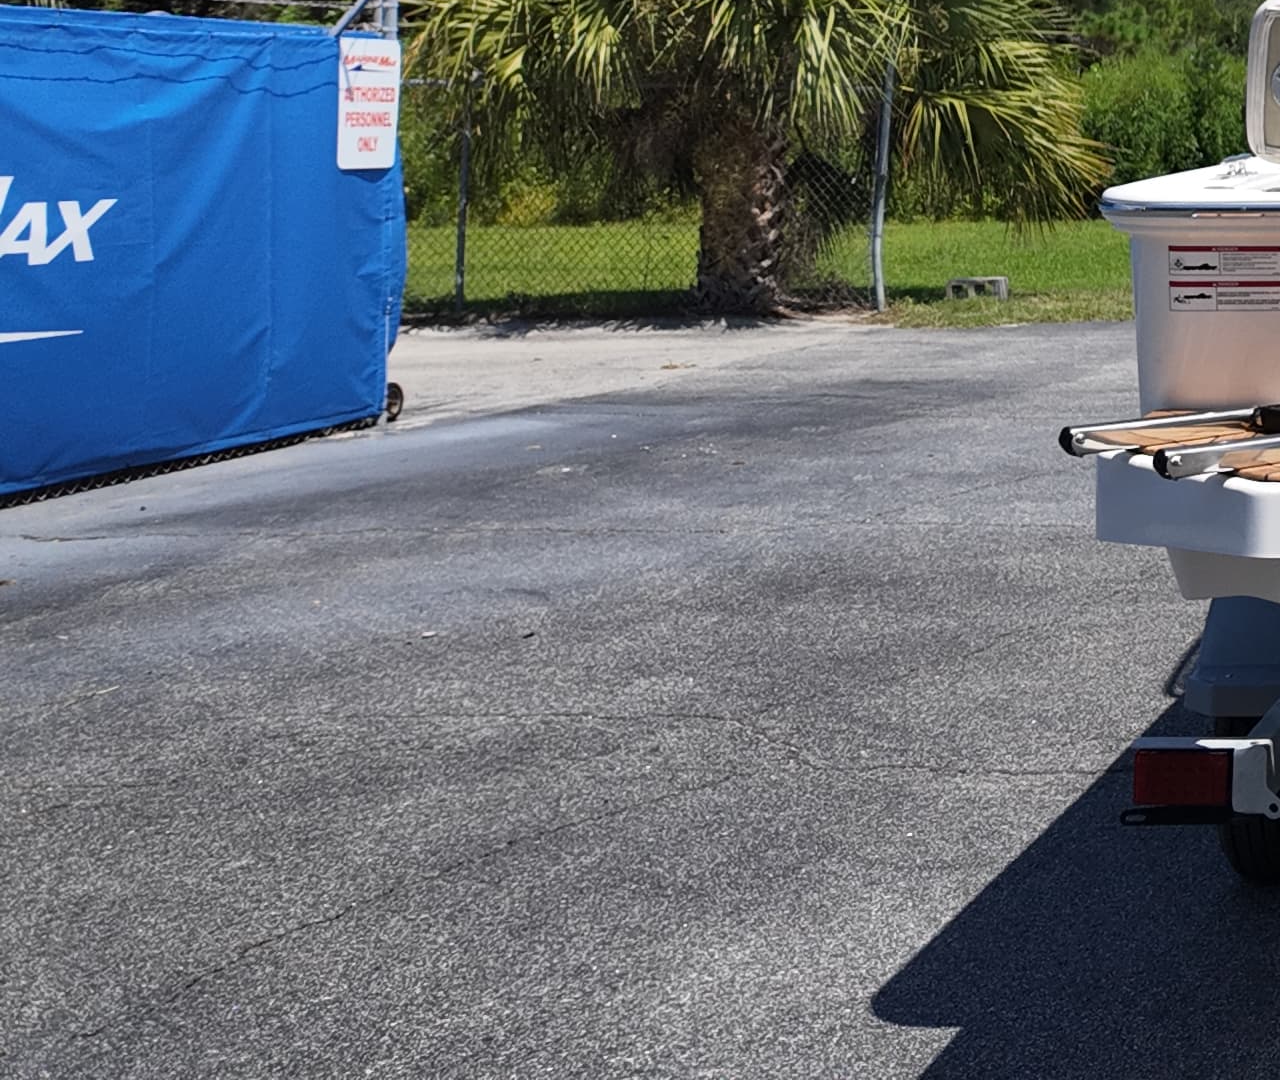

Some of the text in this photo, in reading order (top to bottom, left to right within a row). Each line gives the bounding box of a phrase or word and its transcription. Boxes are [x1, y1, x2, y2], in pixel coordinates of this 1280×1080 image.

[344, 87, 395, 102] AUTHORIZED
[345, 112, 392, 127] PERSONNEL
[358, 137, 378, 152] ONLY
